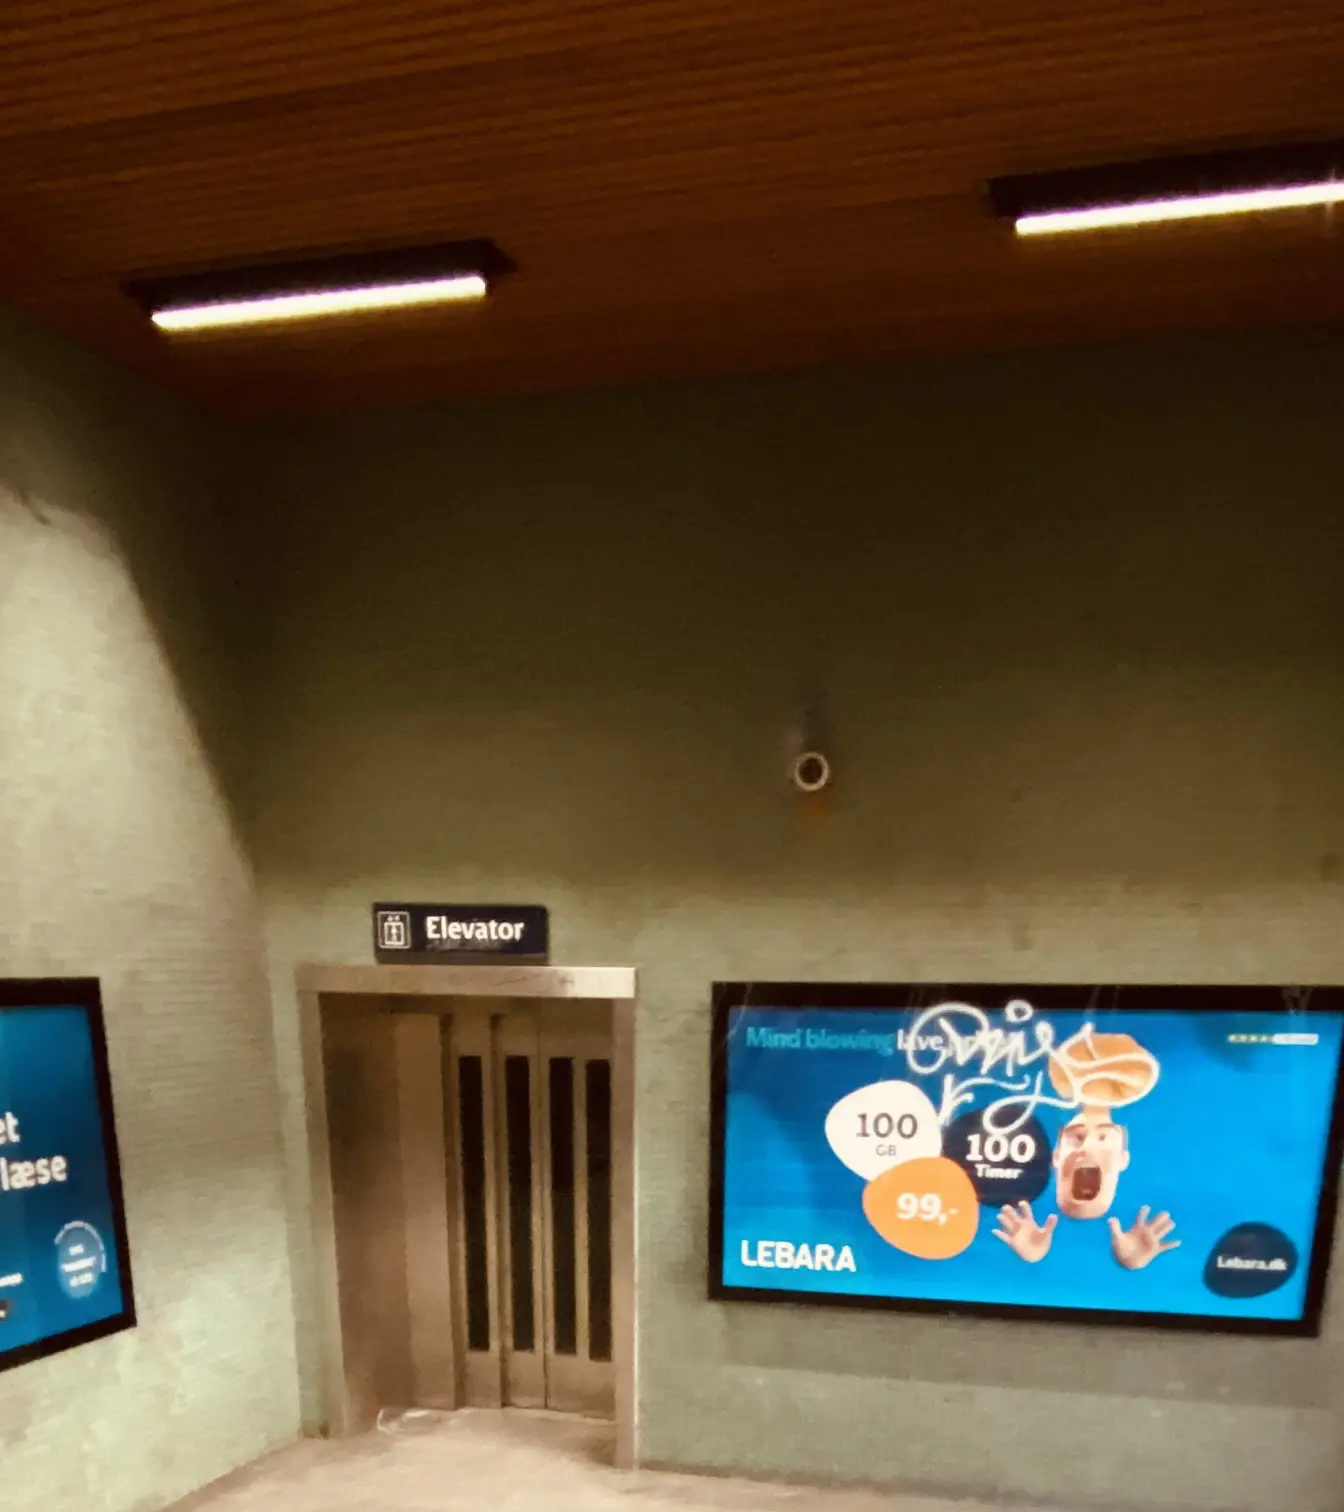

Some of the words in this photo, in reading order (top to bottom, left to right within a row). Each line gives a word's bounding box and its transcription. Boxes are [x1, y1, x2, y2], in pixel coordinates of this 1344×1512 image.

[426, 915, 525, 941] Elevator
[745, 1027, 801, 1050] Mind
[806, 1028, 894, 1057] blowing
[856, 1112, 918, 1139] 100
[875, 1144, 897, 1157] GB
[965, 1133, 1036, 1163] 100
[974, 1163, 1024, 1179] Timer
[895, 1192, 960, 1225] 99,-
[741, 1239, 856, 1273] LEBARA
